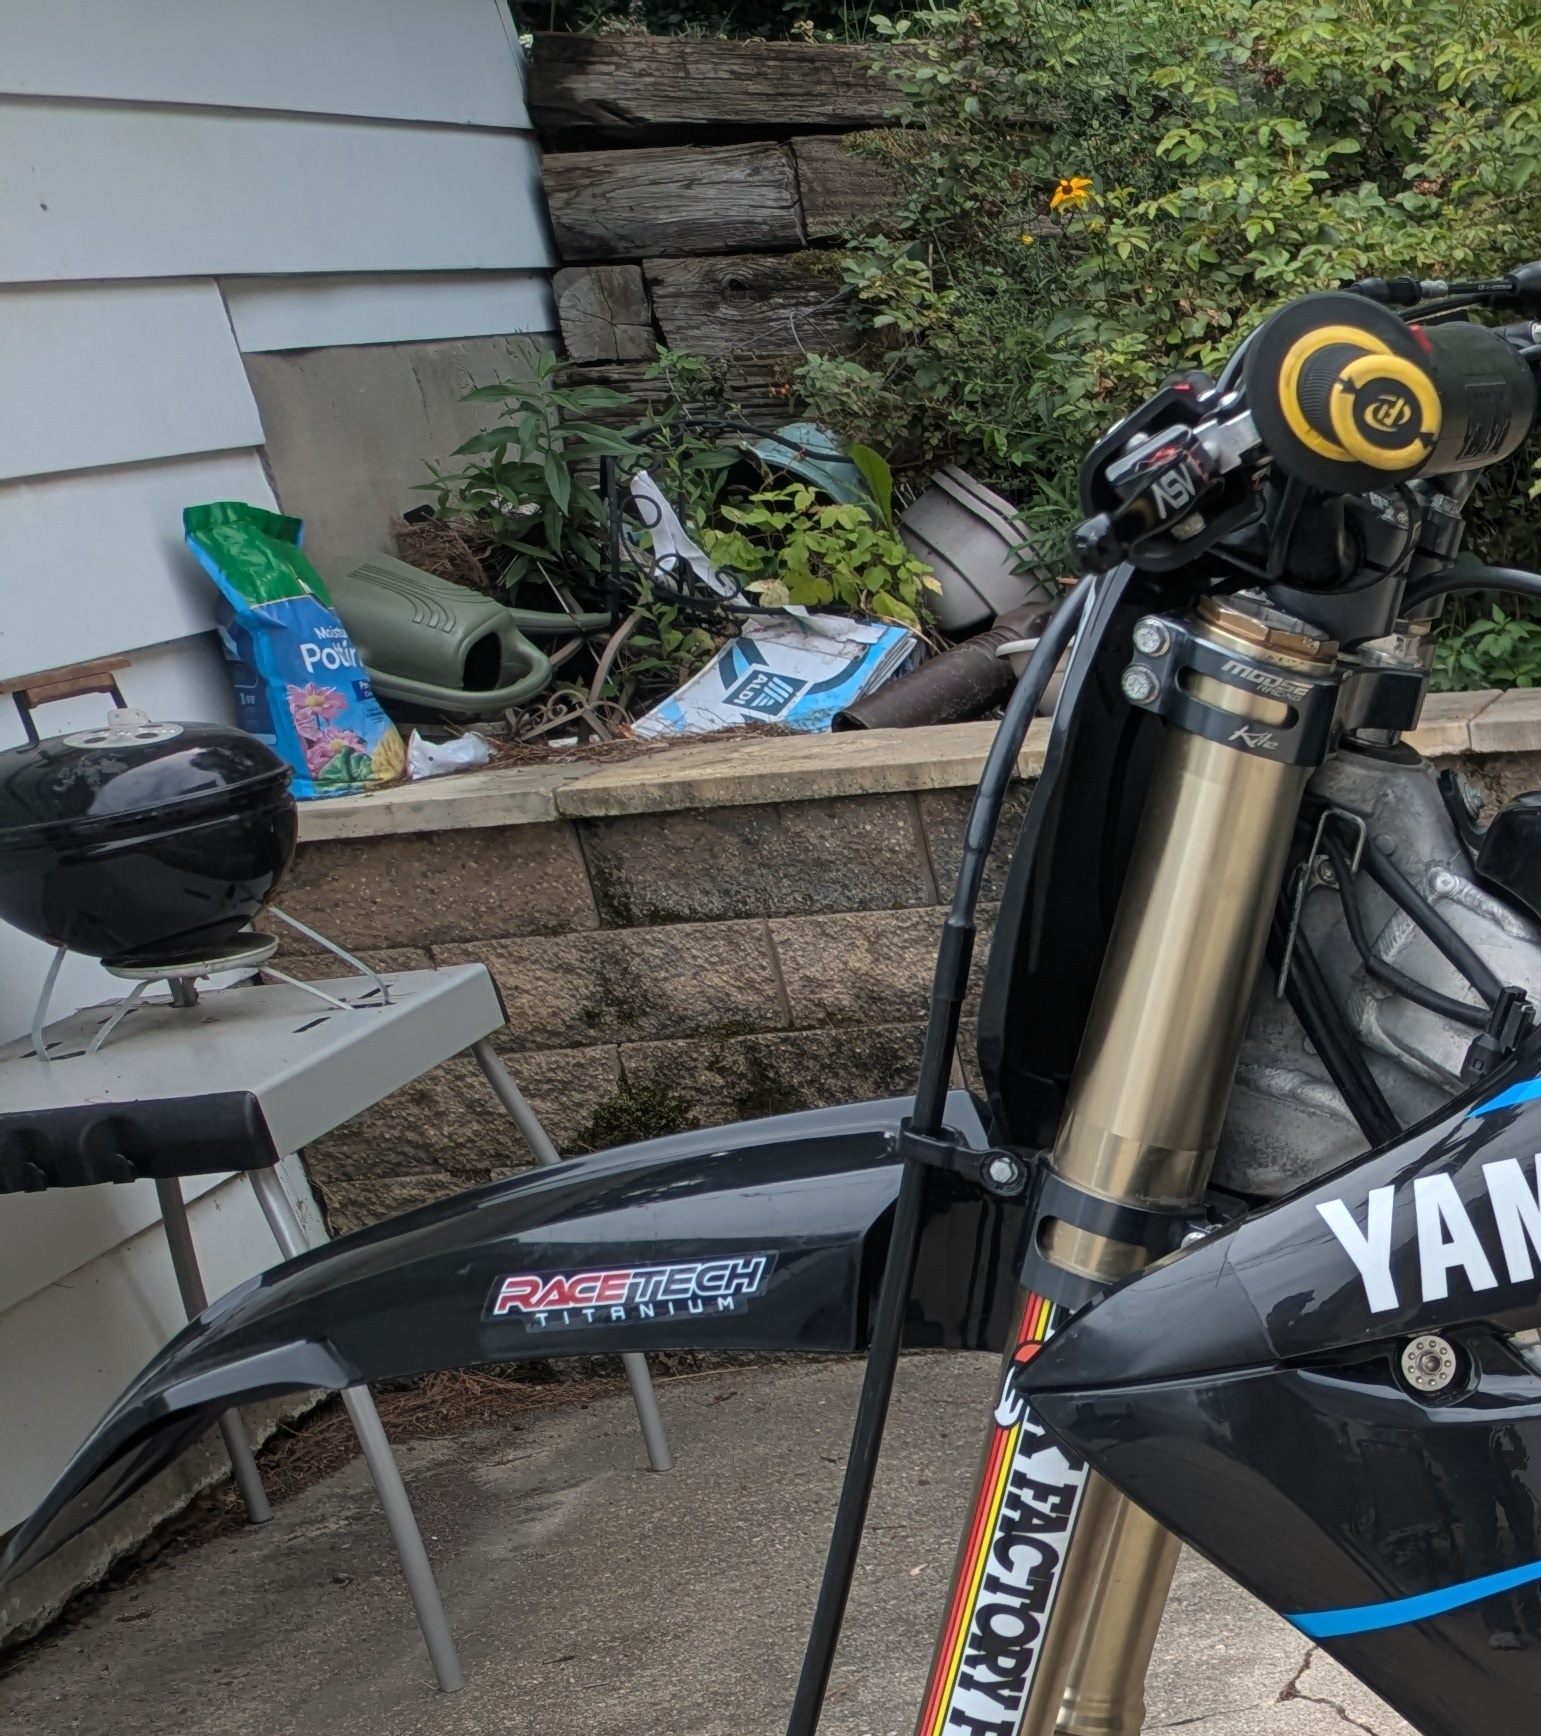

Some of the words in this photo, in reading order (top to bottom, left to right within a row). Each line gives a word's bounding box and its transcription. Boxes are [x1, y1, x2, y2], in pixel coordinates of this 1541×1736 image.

[1151, 462, 1196, 520] ASV
[733, 674, 768, 705] ALDI
[535, 1296, 735, 1327] TITANIUM
[957, 1470, 1079, 1702] FACTORY
